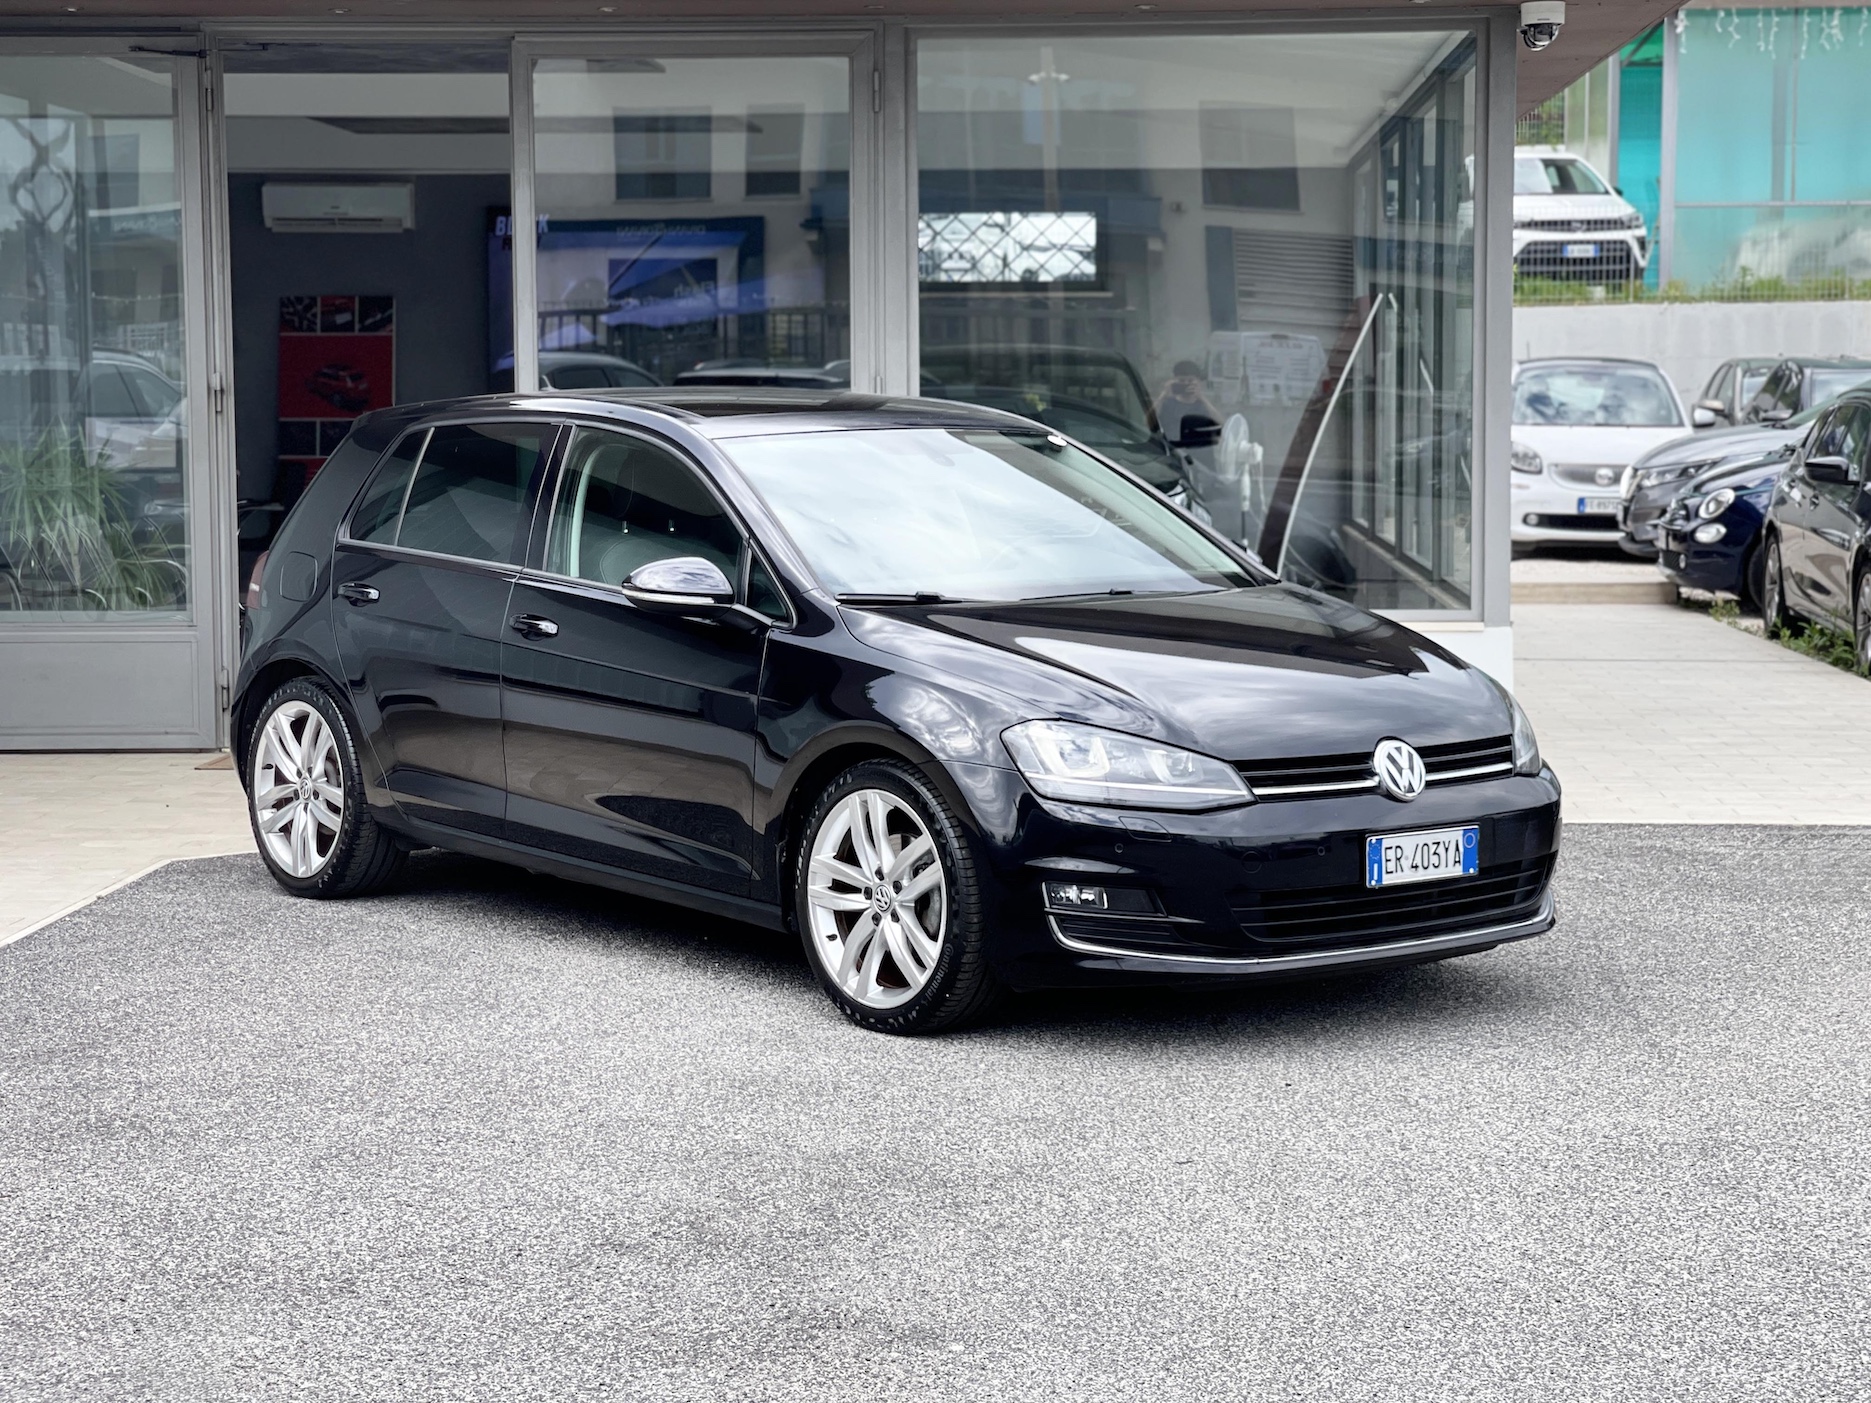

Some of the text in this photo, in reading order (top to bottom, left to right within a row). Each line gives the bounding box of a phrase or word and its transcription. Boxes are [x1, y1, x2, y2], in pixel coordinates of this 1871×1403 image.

[495, 213, 550, 236] BLK
[1377, 741, 1425, 798] VW
[1384, 839, 1462, 875] ER 403YA
[874, 885, 891, 910] VW
[923, 943, 954, 1001] Continental
